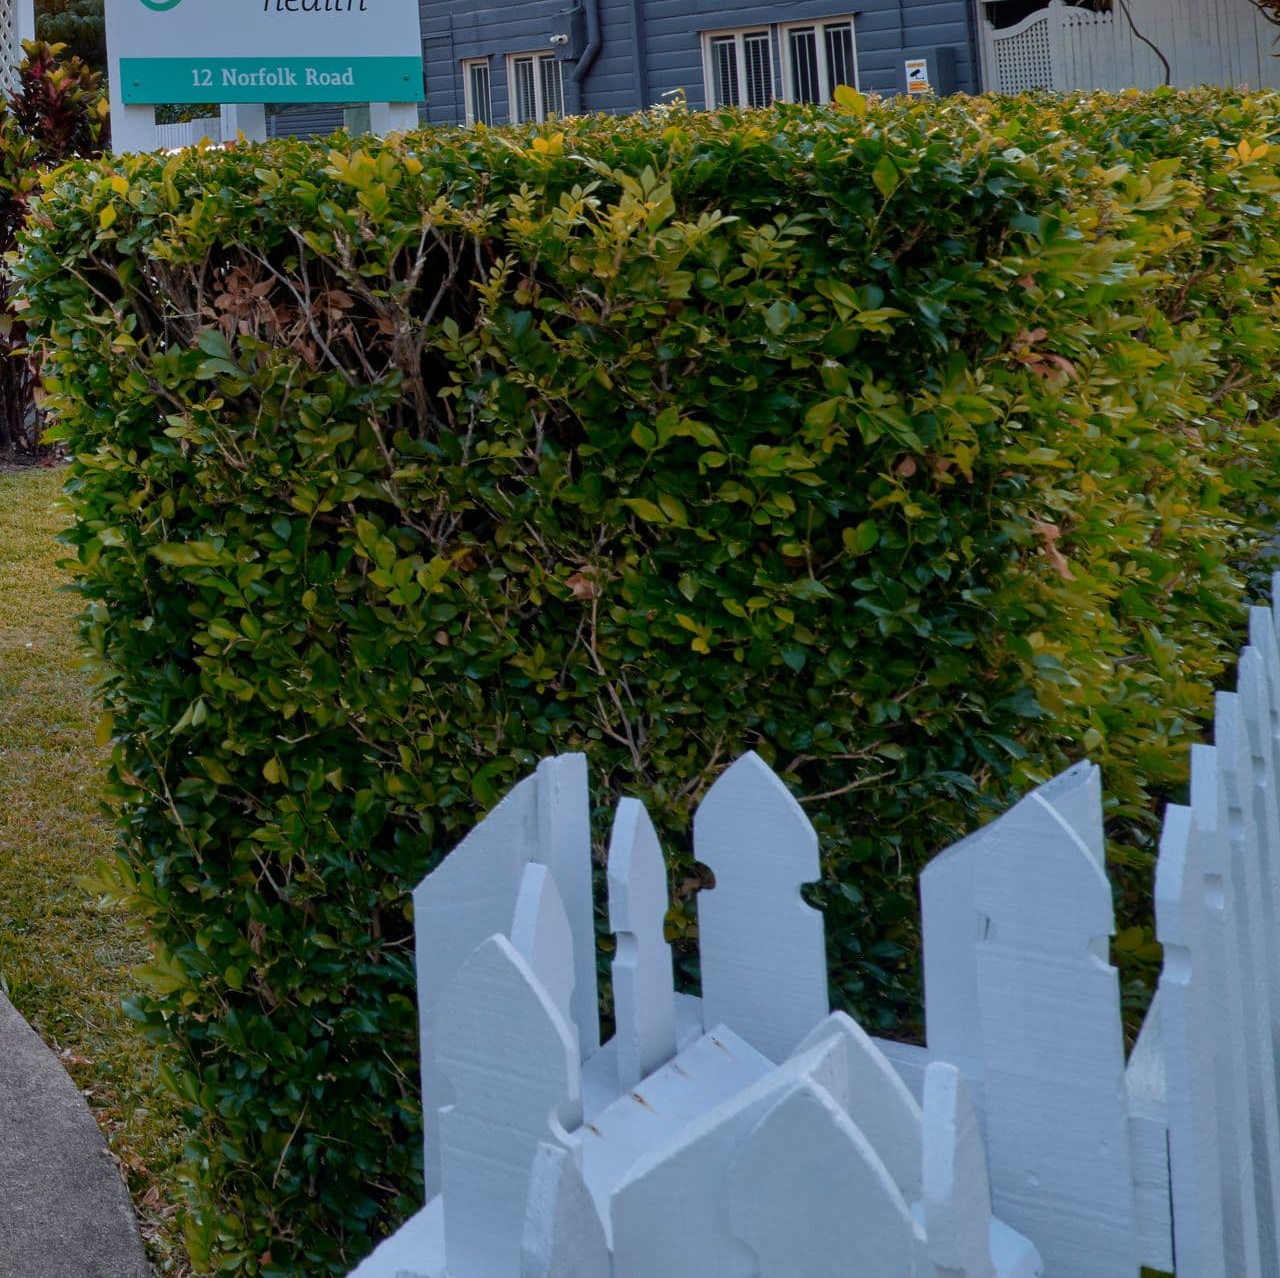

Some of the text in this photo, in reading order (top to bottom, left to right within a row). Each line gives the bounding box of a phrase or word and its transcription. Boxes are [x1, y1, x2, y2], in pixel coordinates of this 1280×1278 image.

[191, 67, 355, 87] 12 Norfolk Road
